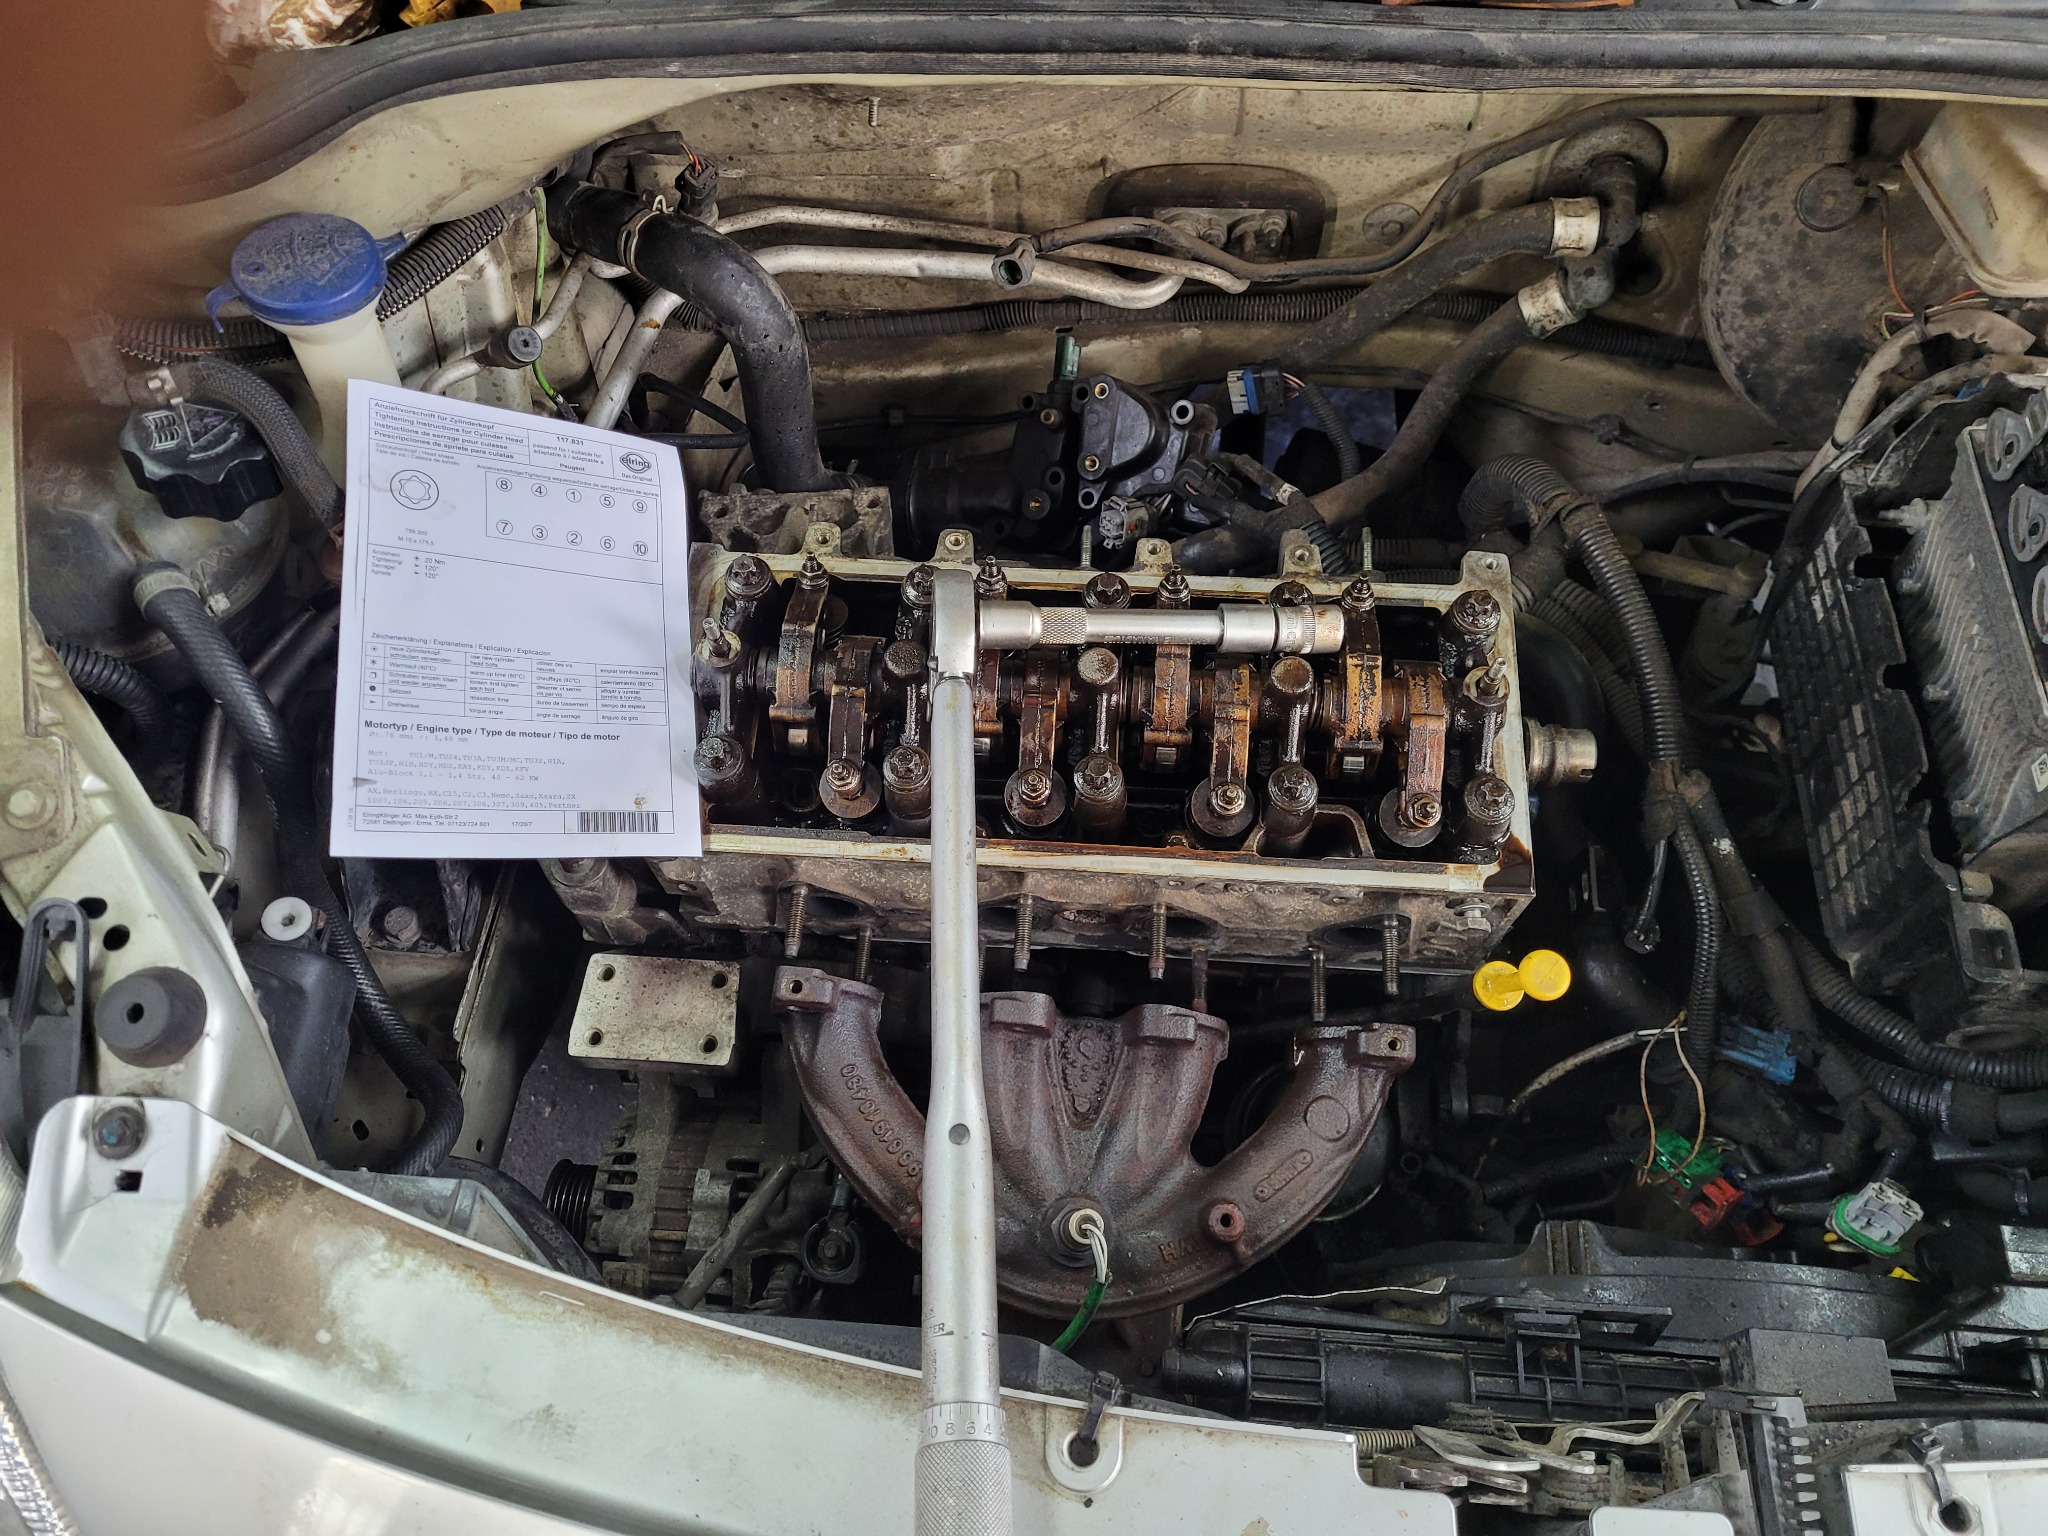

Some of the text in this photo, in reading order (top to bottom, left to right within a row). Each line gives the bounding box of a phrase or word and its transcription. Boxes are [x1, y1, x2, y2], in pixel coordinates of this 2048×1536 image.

[374, 402, 494, 430] Anziehvorschrift für Zylinderkopf
[375, 412, 414, 425] Tightening
[474, 430, 504, 440] Cylinder
[505, 436, 524, 444] Head
[374, 421, 418, 434] Instructions
[432, 434, 460, 442] serrage
[462, 438, 478, 446] pour
[480, 442, 508, 450] culasse
[374, 430, 430, 446] Prescripciones
[444, 444, 468, 452] apriete
[556, 436, 584, 446] 117.831
[532, 443, 558, 452] passend
[533, 449, 599, 464] adaptable adaptable
[622, 456, 652, 470] elring
[560, 463, 585, 472] Peugeot
[633, 474, 653, 482] Original
[635, 544, 646, 554] 10
[372, 632, 427, 644] Zeichenerklärung
[433, 639, 473, 648] Explanations
[479, 644, 511, 652] Explication
[364, 720, 407, 731] Motortyp
[417, 724, 449, 733] Engine
[452, 726, 472, 735] type
[480, 728, 502, 736] Type
[558, 732, 578, 740] Tipo
[581, 732, 591, 740] de
[946, 1422, 955, 1435] 8
[966, 1422, 976, 1434] 6
[983, 1423, 992, 1436] 4
